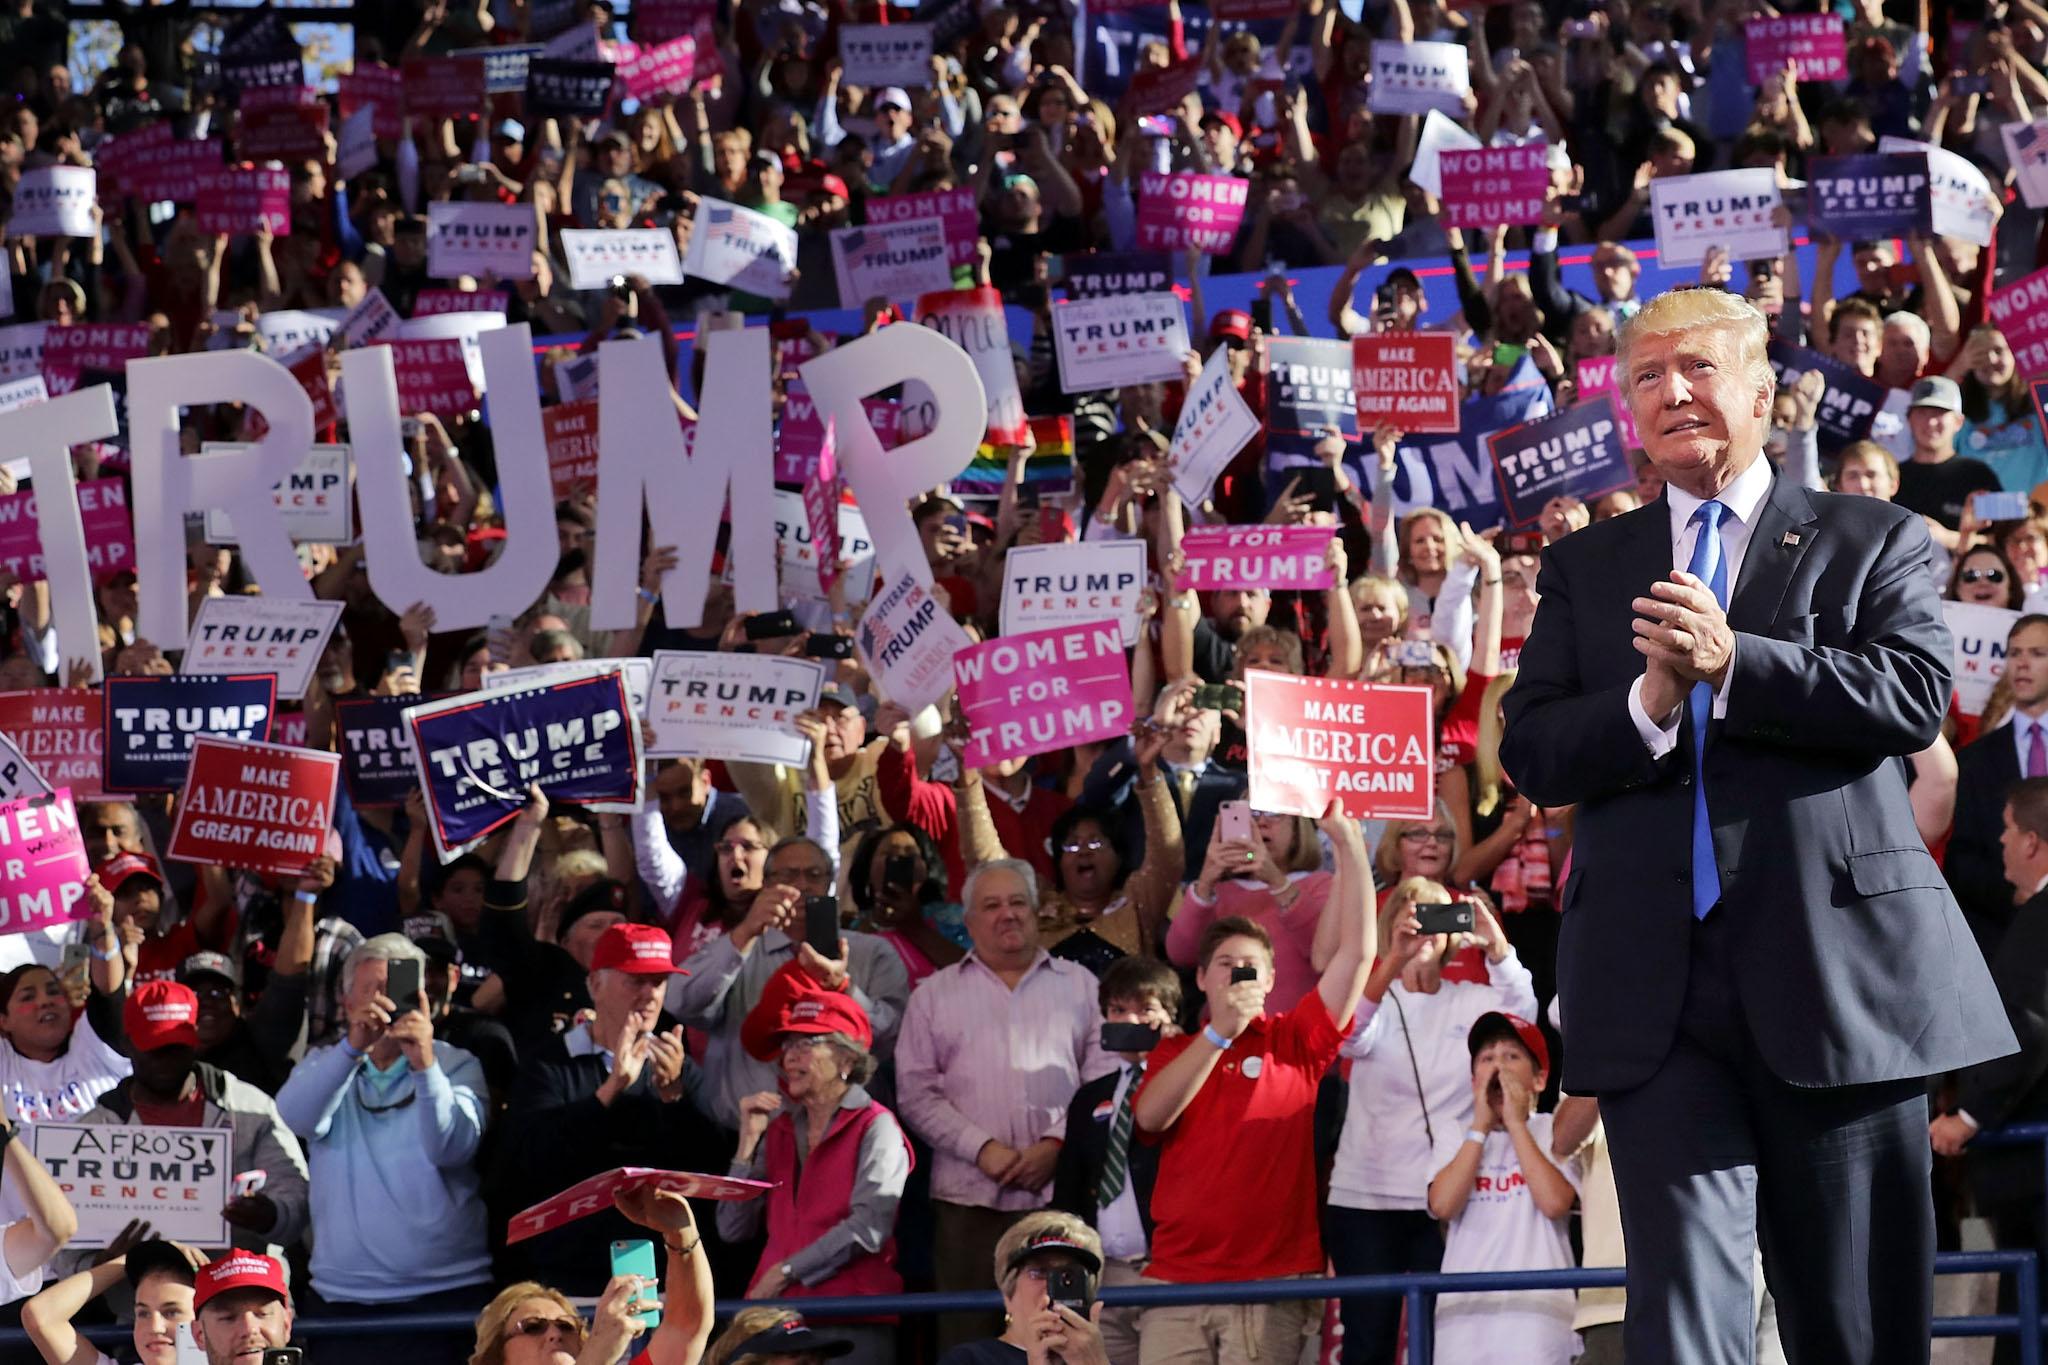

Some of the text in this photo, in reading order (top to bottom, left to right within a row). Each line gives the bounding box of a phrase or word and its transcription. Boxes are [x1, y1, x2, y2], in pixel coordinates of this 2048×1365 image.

[1747, 17, 1844, 39] WOMEN
[847, 40, 925, 55] TRUMP
[1440, 153, 1546, 174] WOMEN
[197, 172, 291, 192] WOMEN
[1141, 175, 1248, 206] WOMEN
[1472, 180, 1512, 195] FOR
[1813, 175, 1926, 197] TRUMP
[867, 193, 975, 222] WOMEN
[1446, 201, 1543, 222] TRUMP
[1662, 194, 1773, 219] TRUMP
[1824, 193, 1918, 210] PENCE
[1174, 206, 1215, 224] FOR
[1674, 214, 1769, 230] PENCE
[438, 222, 530, 239] TRUMP
[1144, 226, 1231, 249] TRUMP
[575, 241, 667, 257] TRUMP
[862, 245, 946, 268] TRUMP
[1071, 272, 1166, 291] TRUMP
[416, 294, 507, 312] WOMEN
[47, 329, 150, 348] WOMEN
[1066, 316, 1176, 343] TRUMP
[1077, 336, 1166, 355] PENCE
[1378, 346, 1416, 363] MAKE
[1270, 362, 1351, 388] TRUM
[1356, 367, 1454, 394] AMERICA
[1397, 396, 1447, 413] AGAIN
[554, 414, 587, 432] MAKE
[1500, 419, 1614, 477] TRUMP
[1514, 442, 1608, 489] PENCE
[1228, 531, 1284, 548] FOR
[1185, 555, 1325, 583] TRUMP
[1014, 572, 1135, 595] TRUMP
[876, 572, 916, 620] VETERANS
[905, 585, 926, 609] FOR
[1021, 595, 1123, 611] PENCE
[204, 624, 319, 643] TRUMP
[880, 599, 935, 669] TRUMP
[203, 645, 299, 659] PENCE
[954, 627, 1123, 686] WOMEN
[660, 679, 807, 706] TRUMP
[1009, 676, 1070, 707] FOR
[32, 705, 86, 723] MAKE
[115, 703, 268, 732] TRUMP
[667, 701, 788, 722] PENCE
[1304, 700, 1366, 725] MAKE
[971, 699, 1125, 758] TRUMP
[346, 728, 415, 752] TRU
[430, 709, 621, 779] TRUMP
[360, 752, 418, 769] PEN
[241, 765, 292, 788] MAKE
[1335, 770, 1415, 794] AGAIN
[186, 785, 328, 830] AMERICA
[190, 820, 317, 854] GREAT AGAIN
[45, 1158, 216, 1183] TRUMP
[61, 1183, 199, 1201] PENCE
[85, 1202, 129, 1212] AMERICA
[134, 1204, 165, 1212] GREAT
